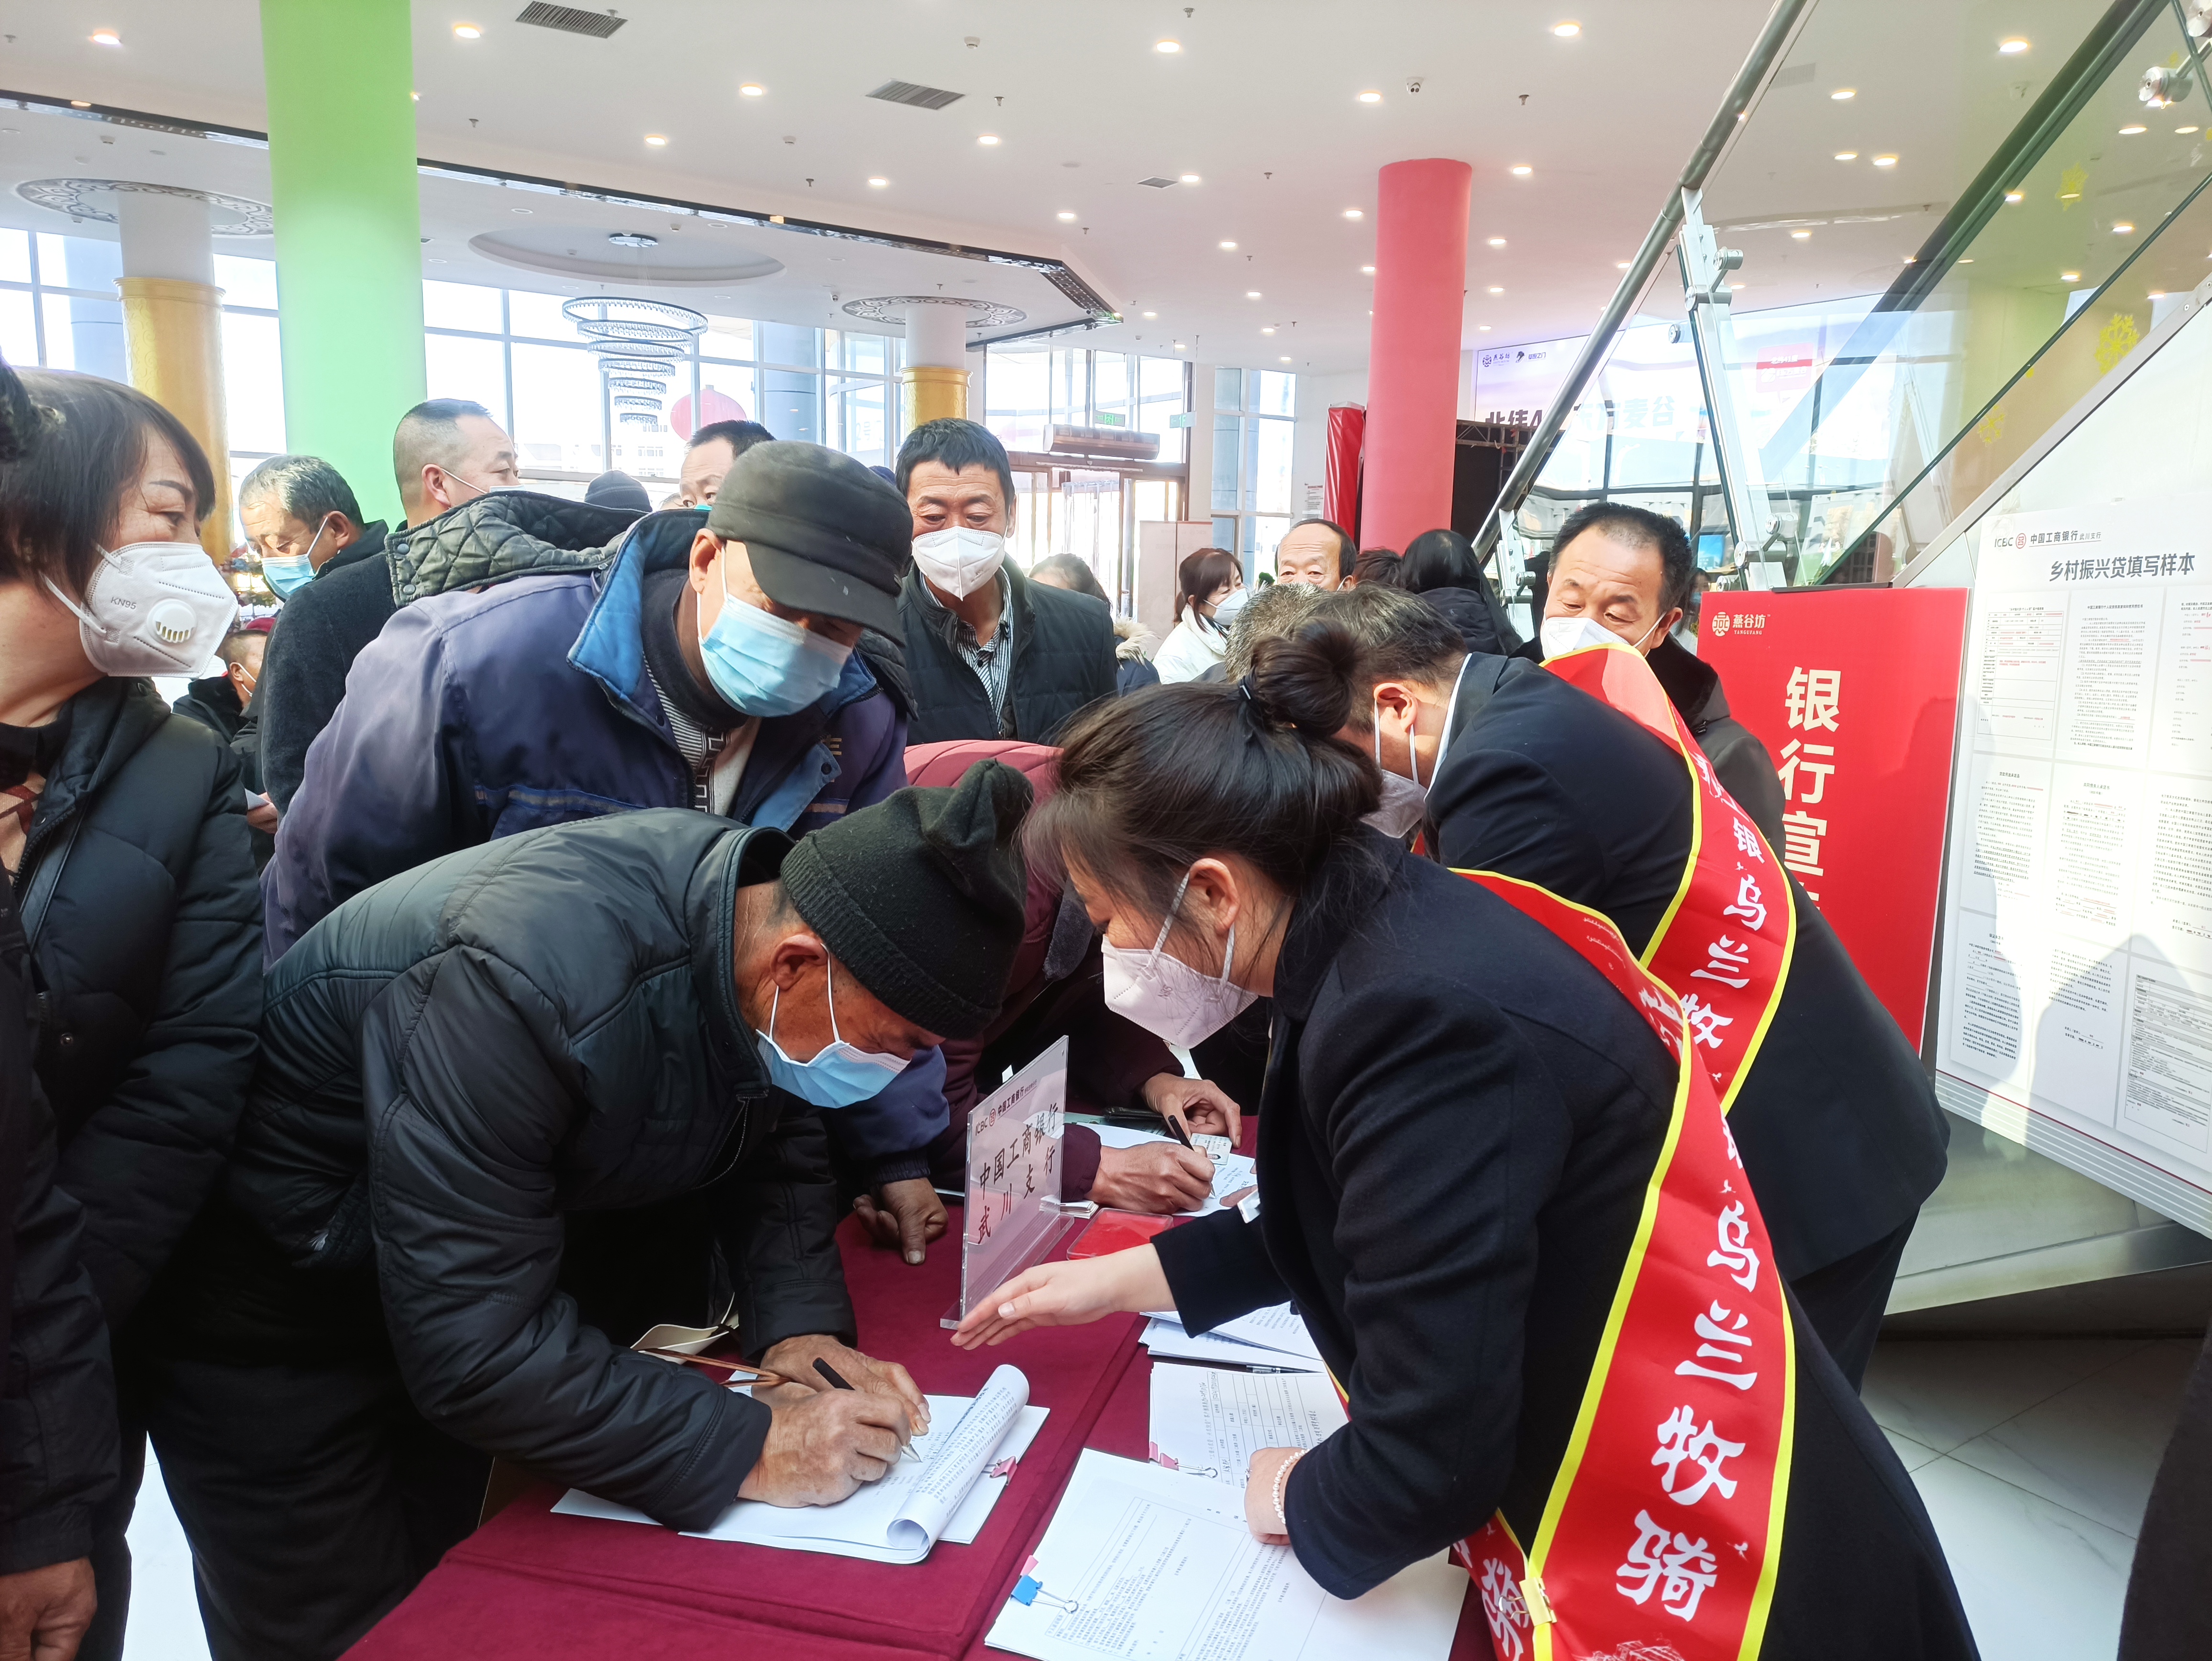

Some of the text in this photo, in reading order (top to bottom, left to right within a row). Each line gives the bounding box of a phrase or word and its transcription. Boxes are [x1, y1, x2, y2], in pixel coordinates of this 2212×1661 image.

[1994, 537, 2013, 548] ICBC
[2030, 531, 2101, 544] 中国工商银行 武川支行
[2049, 552, 2195, 582] 乡村振兴贷填写样本
[111, 597, 137, 609] KN95
[1732, 614, 1767, 629] 燕谷坊
[1778, 666, 1841, 910] 银行宣
[997, 1086, 1024, 1116] 中国工商银行
[975, 1117, 988, 1136] ICBC
[979, 1102, 1058, 1200] 中国工商银行
[977, 1145, 1055, 1246] 武川支行
[1616, 1199, 1762, 1623] 乌兰牧骑
